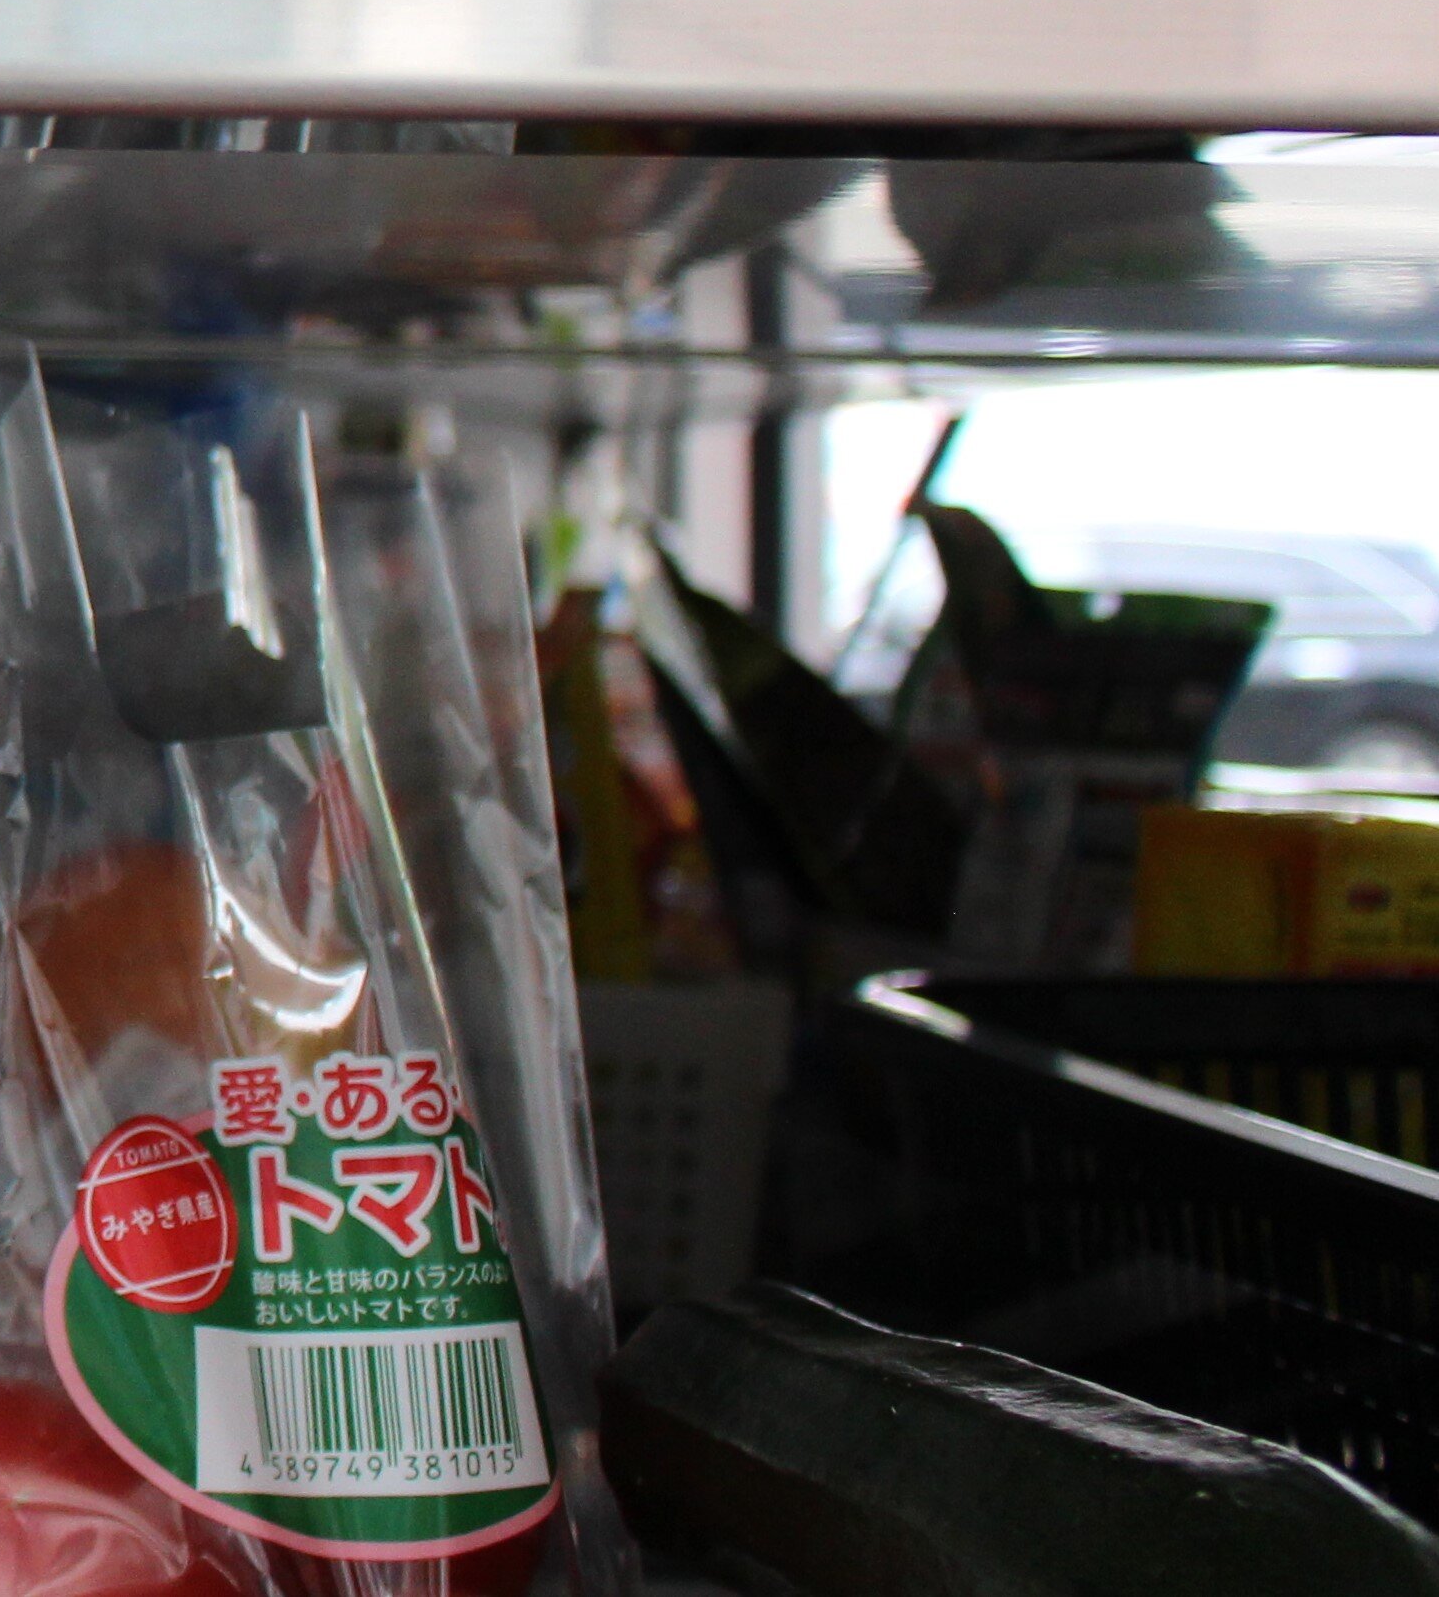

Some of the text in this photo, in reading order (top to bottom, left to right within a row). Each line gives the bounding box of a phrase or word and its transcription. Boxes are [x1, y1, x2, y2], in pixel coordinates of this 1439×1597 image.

[214, 1055, 455, 1143] 愛・ある
[113, 1139, 182, 1168] TOMATO
[100, 1193, 217, 1242] みやぎ県産
[252, 1141, 497, 1259] トマト
[254, 1294, 469, 1325] おいしいトマトです。
[239, 1445, 517, 1482] 4 589749 381015
